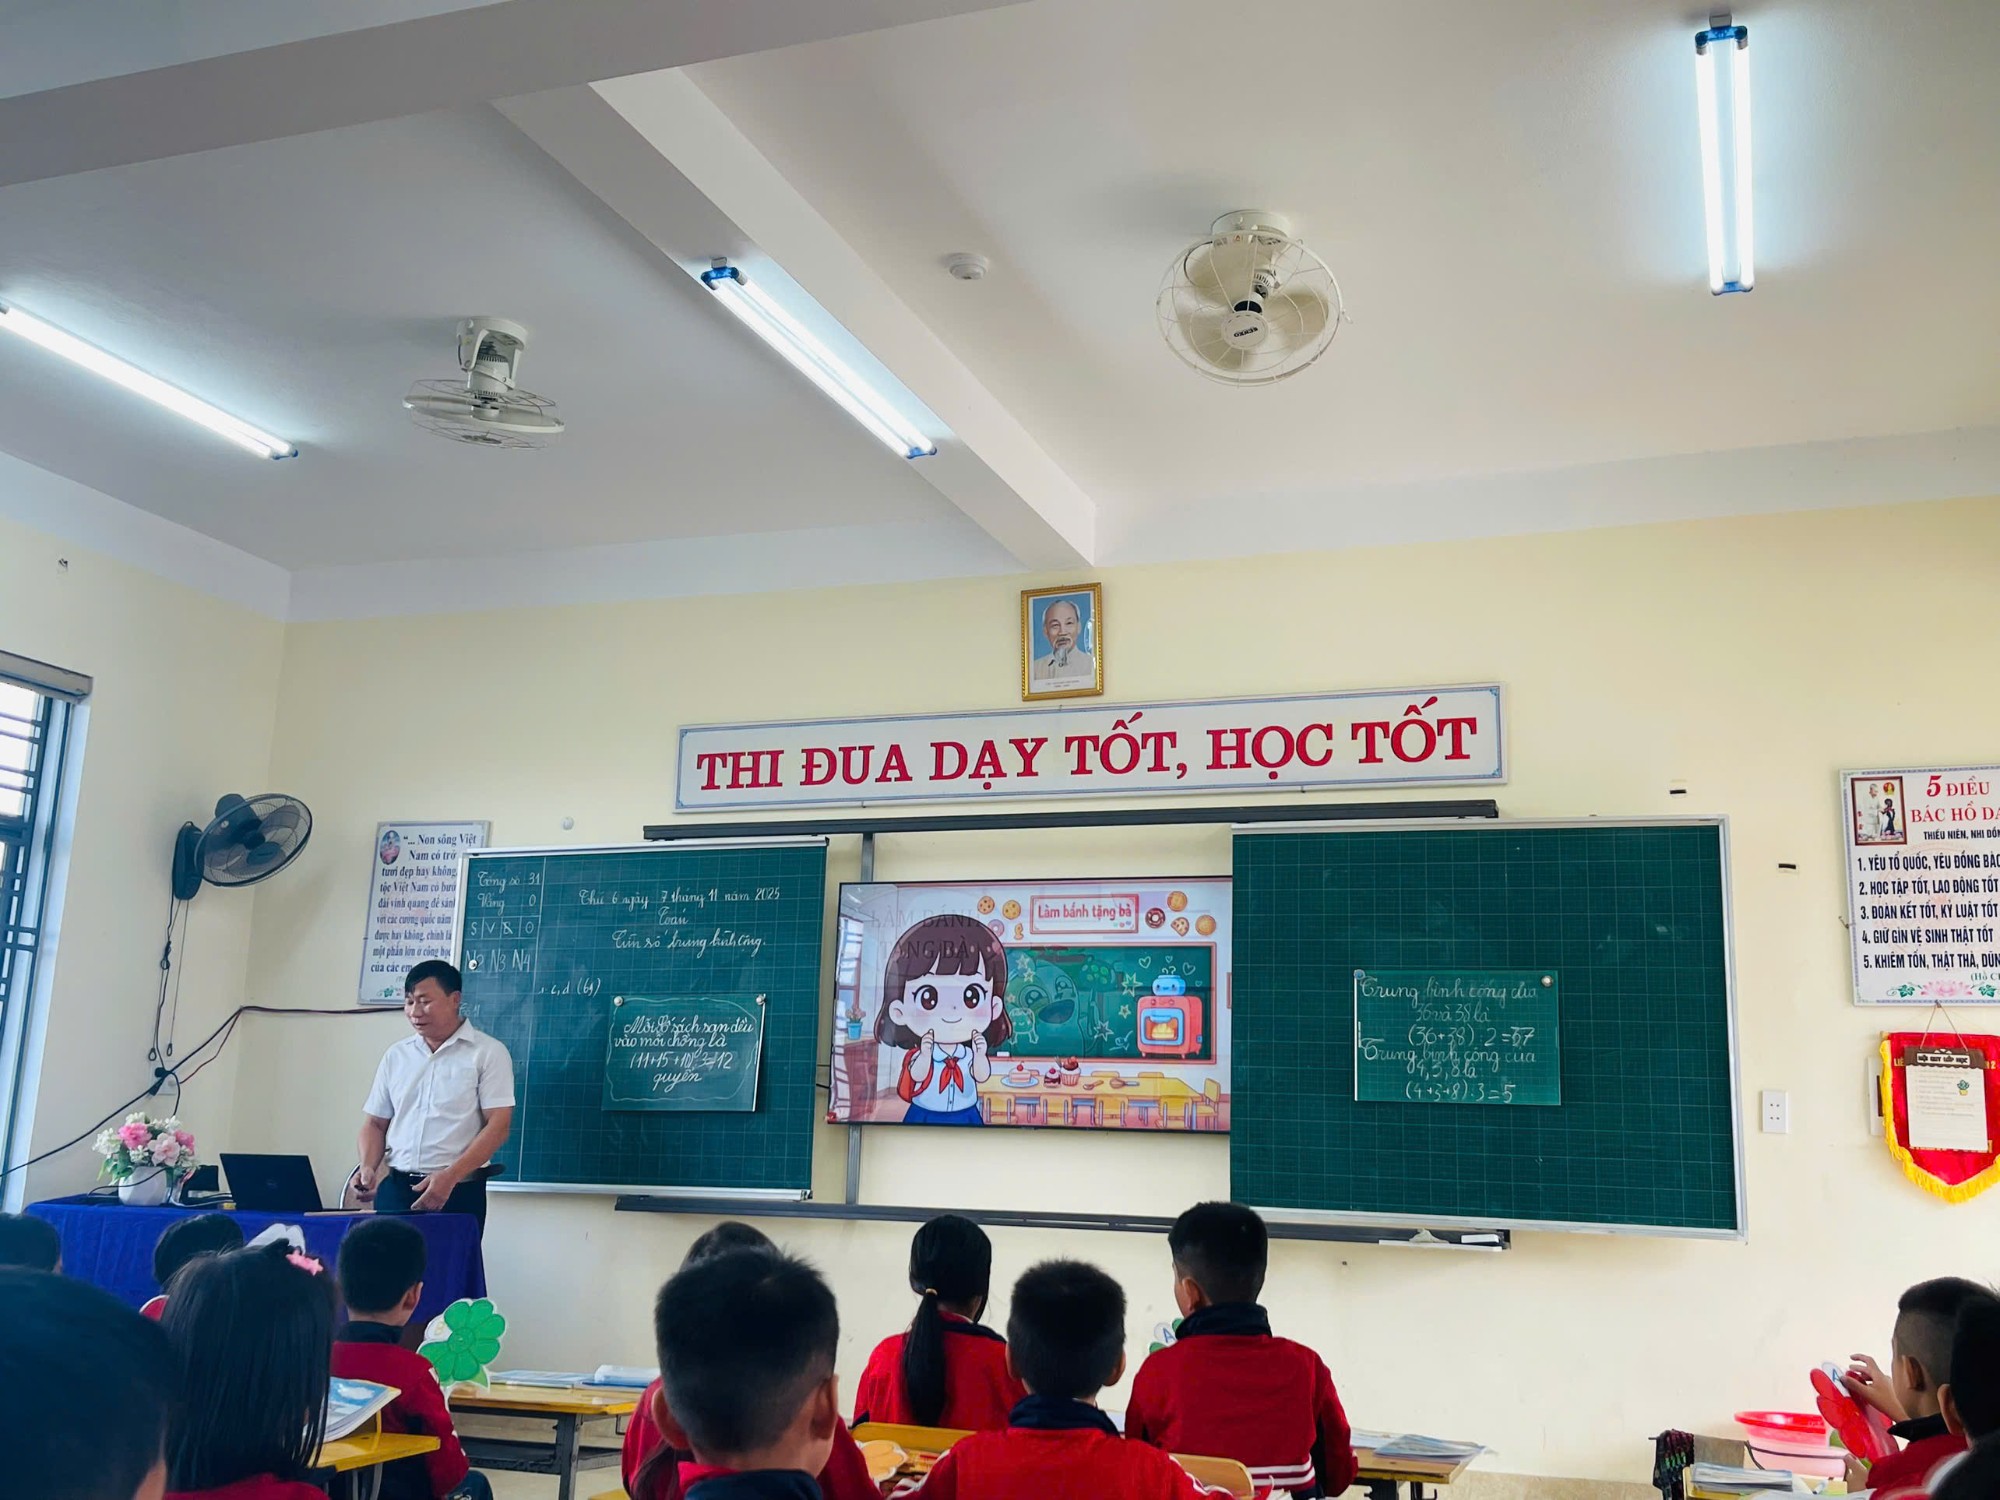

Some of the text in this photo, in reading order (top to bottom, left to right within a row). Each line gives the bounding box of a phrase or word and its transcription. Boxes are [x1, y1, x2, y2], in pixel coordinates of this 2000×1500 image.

[697, 696, 1477, 790] THI ĐUA DẠY TỐT, HỌC TỐT
[1926, 775, 1990, 797] 5 ĐIỀU
[1911, 805, 1945, 822] BÁC
[1951, 801, 1977, 821] HỒ
[418, 833, 476, 846] Non sông Việt
[1923, 829, 1945, 840] THIẾU
[1970, 829, 1984, 839] NHI
[410, 850, 428, 860] Nam
[431, 850, 441, 860] có
[1857, 857, 1866, 871] 1.
[1868, 854, 1886, 871] YÊU
[1888, 851, 1900, 870] TỔ
[1903, 851, 1931, 871] QUỐC,
[1933, 852, 1951, 869] YÊU
[400, 866, 414, 879] đẹp
[416, 866, 429, 878] hay
[528, 872, 540, 885] 31
[394, 881, 409, 894] Việt
[411, 882, 428, 892] Nam
[1859, 874, 1998, 898] 2. HỌC TẬP TỐT, LAO ĐỘNG TỐT
[612, 891, 618, 904] 6
[661, 890, 668, 903] 7
[708, 888, 718, 902] 11
[754, 887, 780, 901] 2025
[407, 899, 429, 910] quang
[1038, 902, 1132, 921] Làm bánh tặng bà
[1860, 906, 1869, 920] 3.
[1872, 903, 1897, 919] ĐOÀN
[1900, 901, 1917, 919] KẾT
[1919, 900, 1938, 920] TỐT,
[1956, 901, 1978, 921] LUẬT
[1981, 899, 1998, 918] TỐT
[1862, 923, 1993, 946] 4. GIỮ GÌN VỆ SINH THẬT TỐT
[371, 962, 385, 972] của
[386, 962, 399, 972] các
[1863, 955, 1872, 968] 5.
[1875, 951, 1905, 968] KHIÊM
[1932, 951, 1954, 971] THẬT
[1163, 1327, 1176, 1343] A
